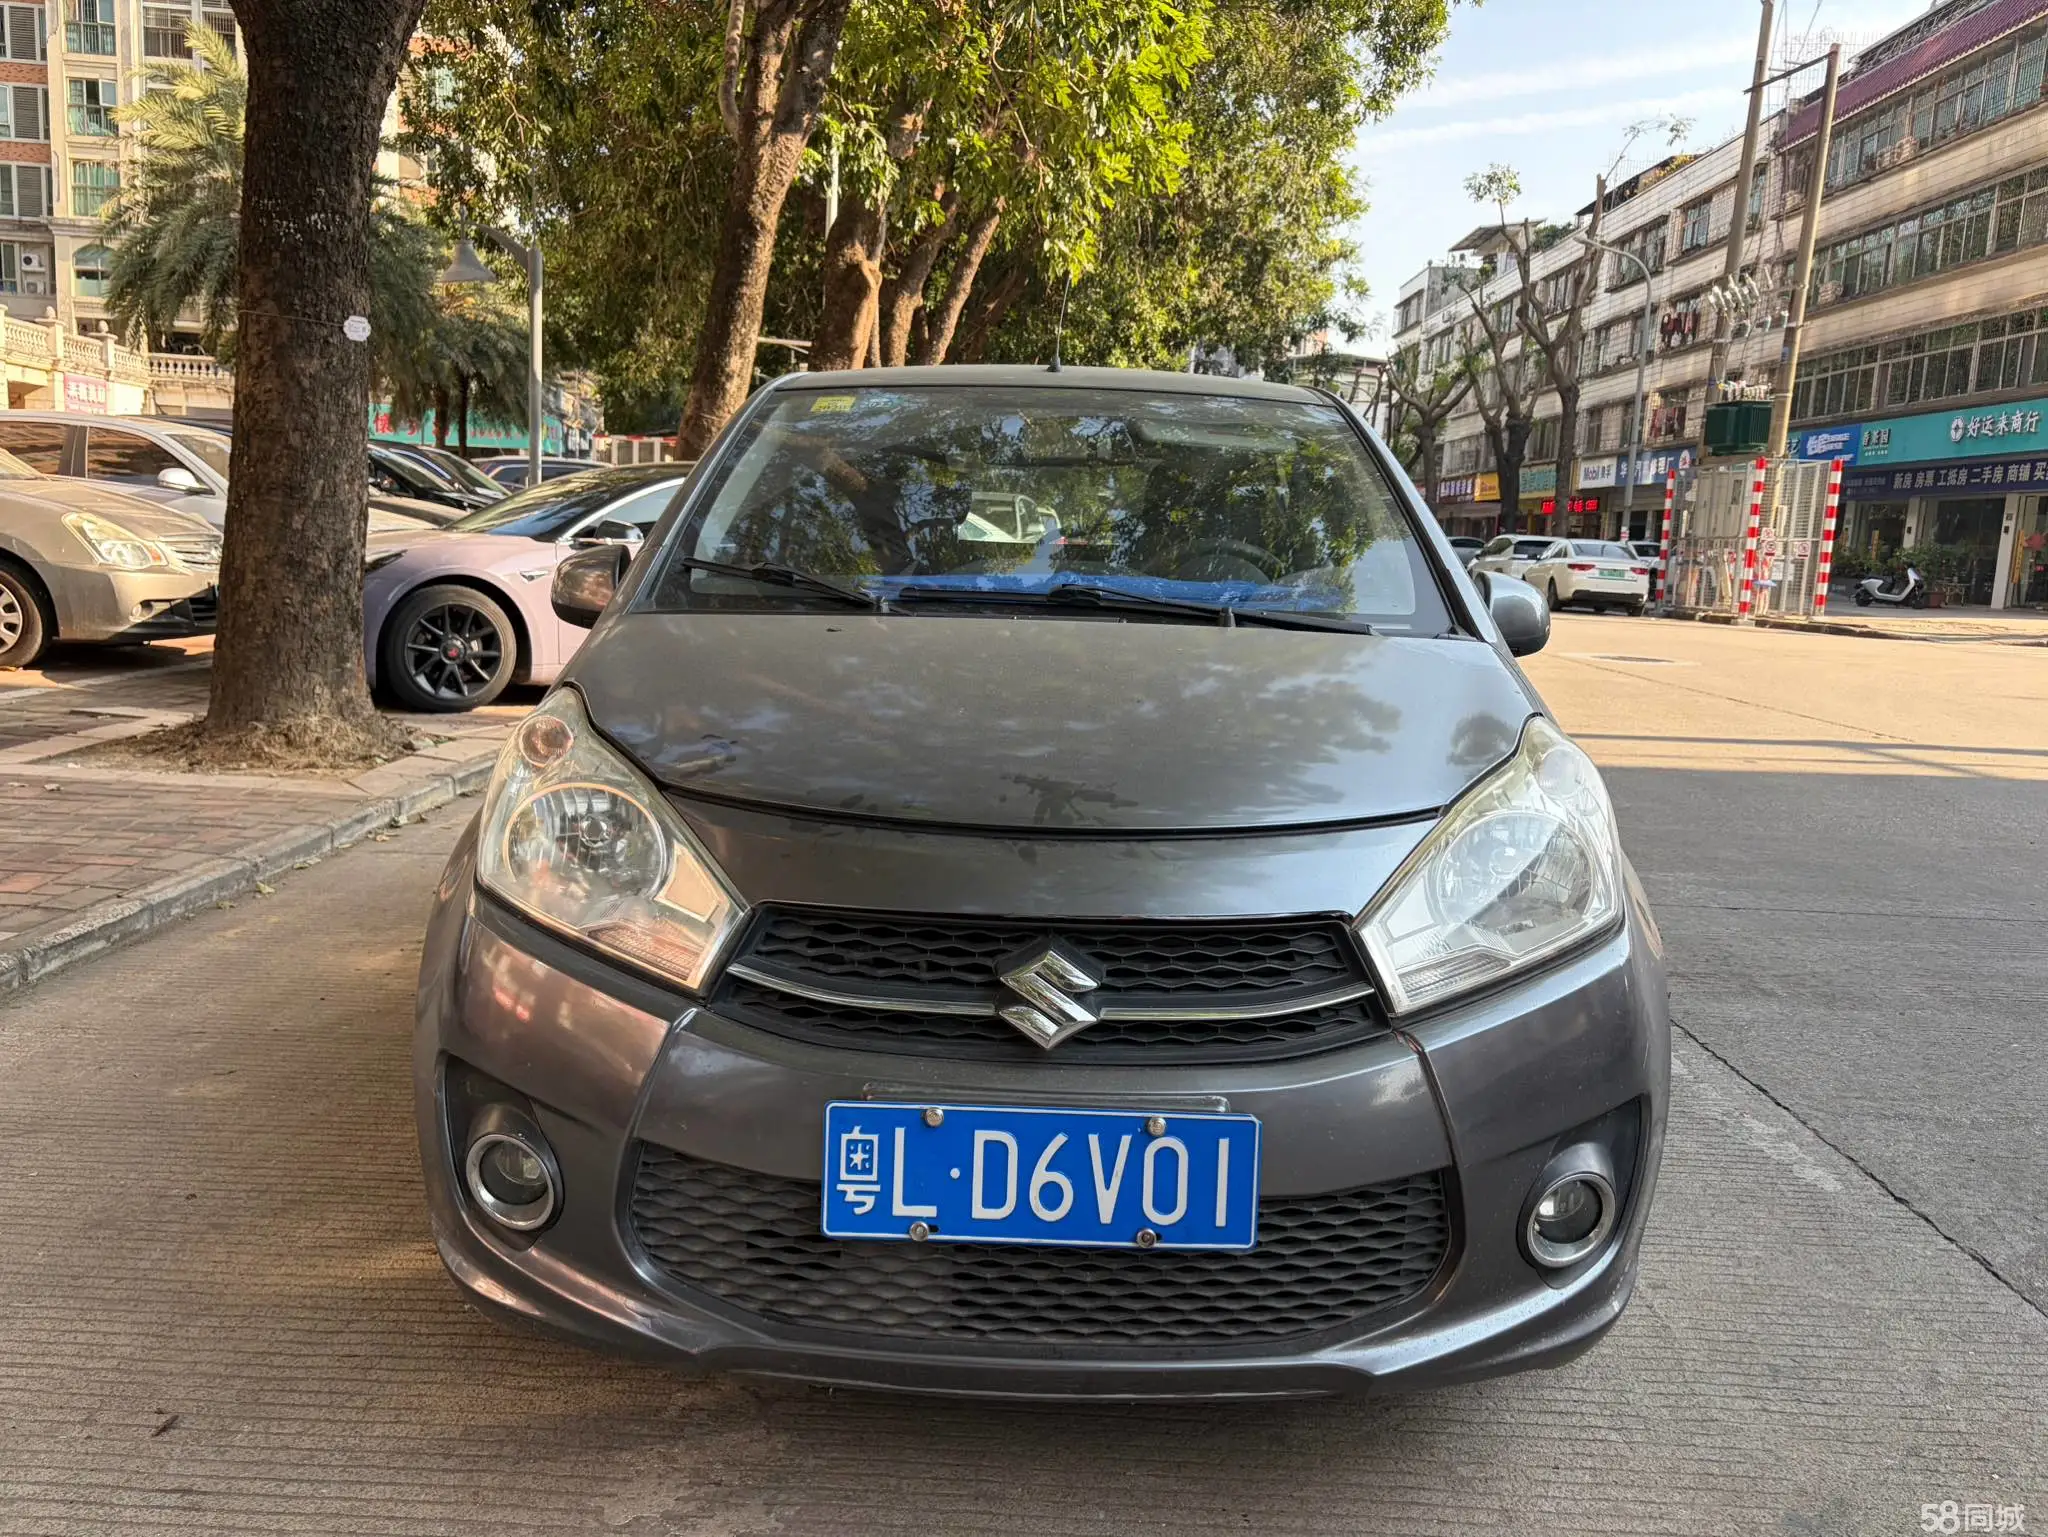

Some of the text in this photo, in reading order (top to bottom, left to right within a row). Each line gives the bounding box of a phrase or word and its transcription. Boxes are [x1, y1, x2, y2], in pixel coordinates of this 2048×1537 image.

[1967, 409, 2040, 437] 好运来商行
[1893, 472, 1913, 490] 新房
[1970, 464, 2004, 484] 二手房
[2006, 463, 2031, 483] 商铺
[2033, 461, 2048, 481] 买
